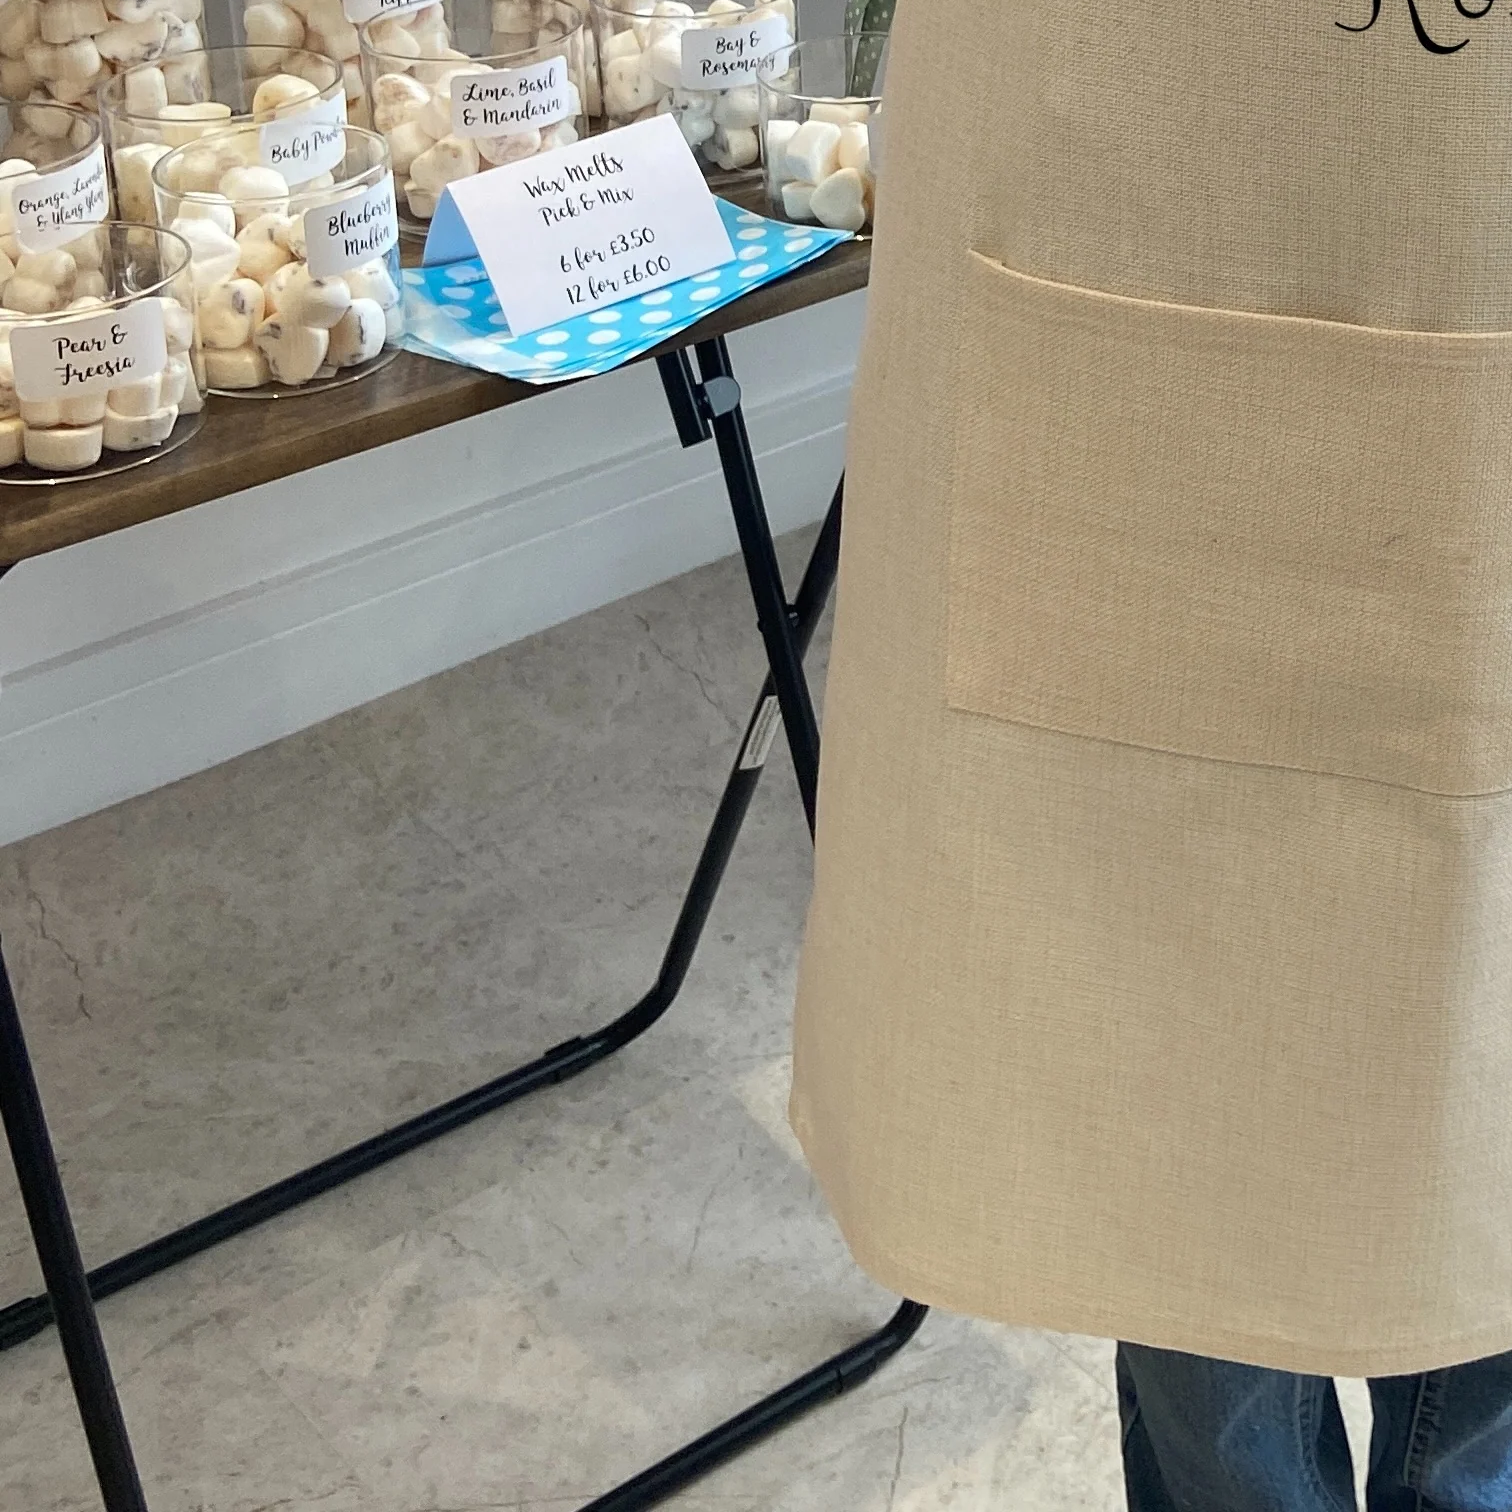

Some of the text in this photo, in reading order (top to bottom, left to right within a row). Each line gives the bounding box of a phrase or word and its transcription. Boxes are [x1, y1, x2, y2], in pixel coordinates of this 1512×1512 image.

[715, 30, 761, 57] Bay &
[462, 67, 557, 102] Lime, Basil
[462, 98, 562, 126] & Mandarin
[270, 136, 310, 165] Baby
[523, 152, 625, 199] Wax Melts
[326, 192, 391, 237] Blueberry
[538, 187, 635, 227] Pick & Mix
[344, 223, 390, 257] Muffin
[560, 226, 656, 273] 6 for £3.50
[566, 255, 671, 305] 12 for £6.00
[52, 324, 129, 360] Pear &
[54, 356, 136, 386] Freesia
